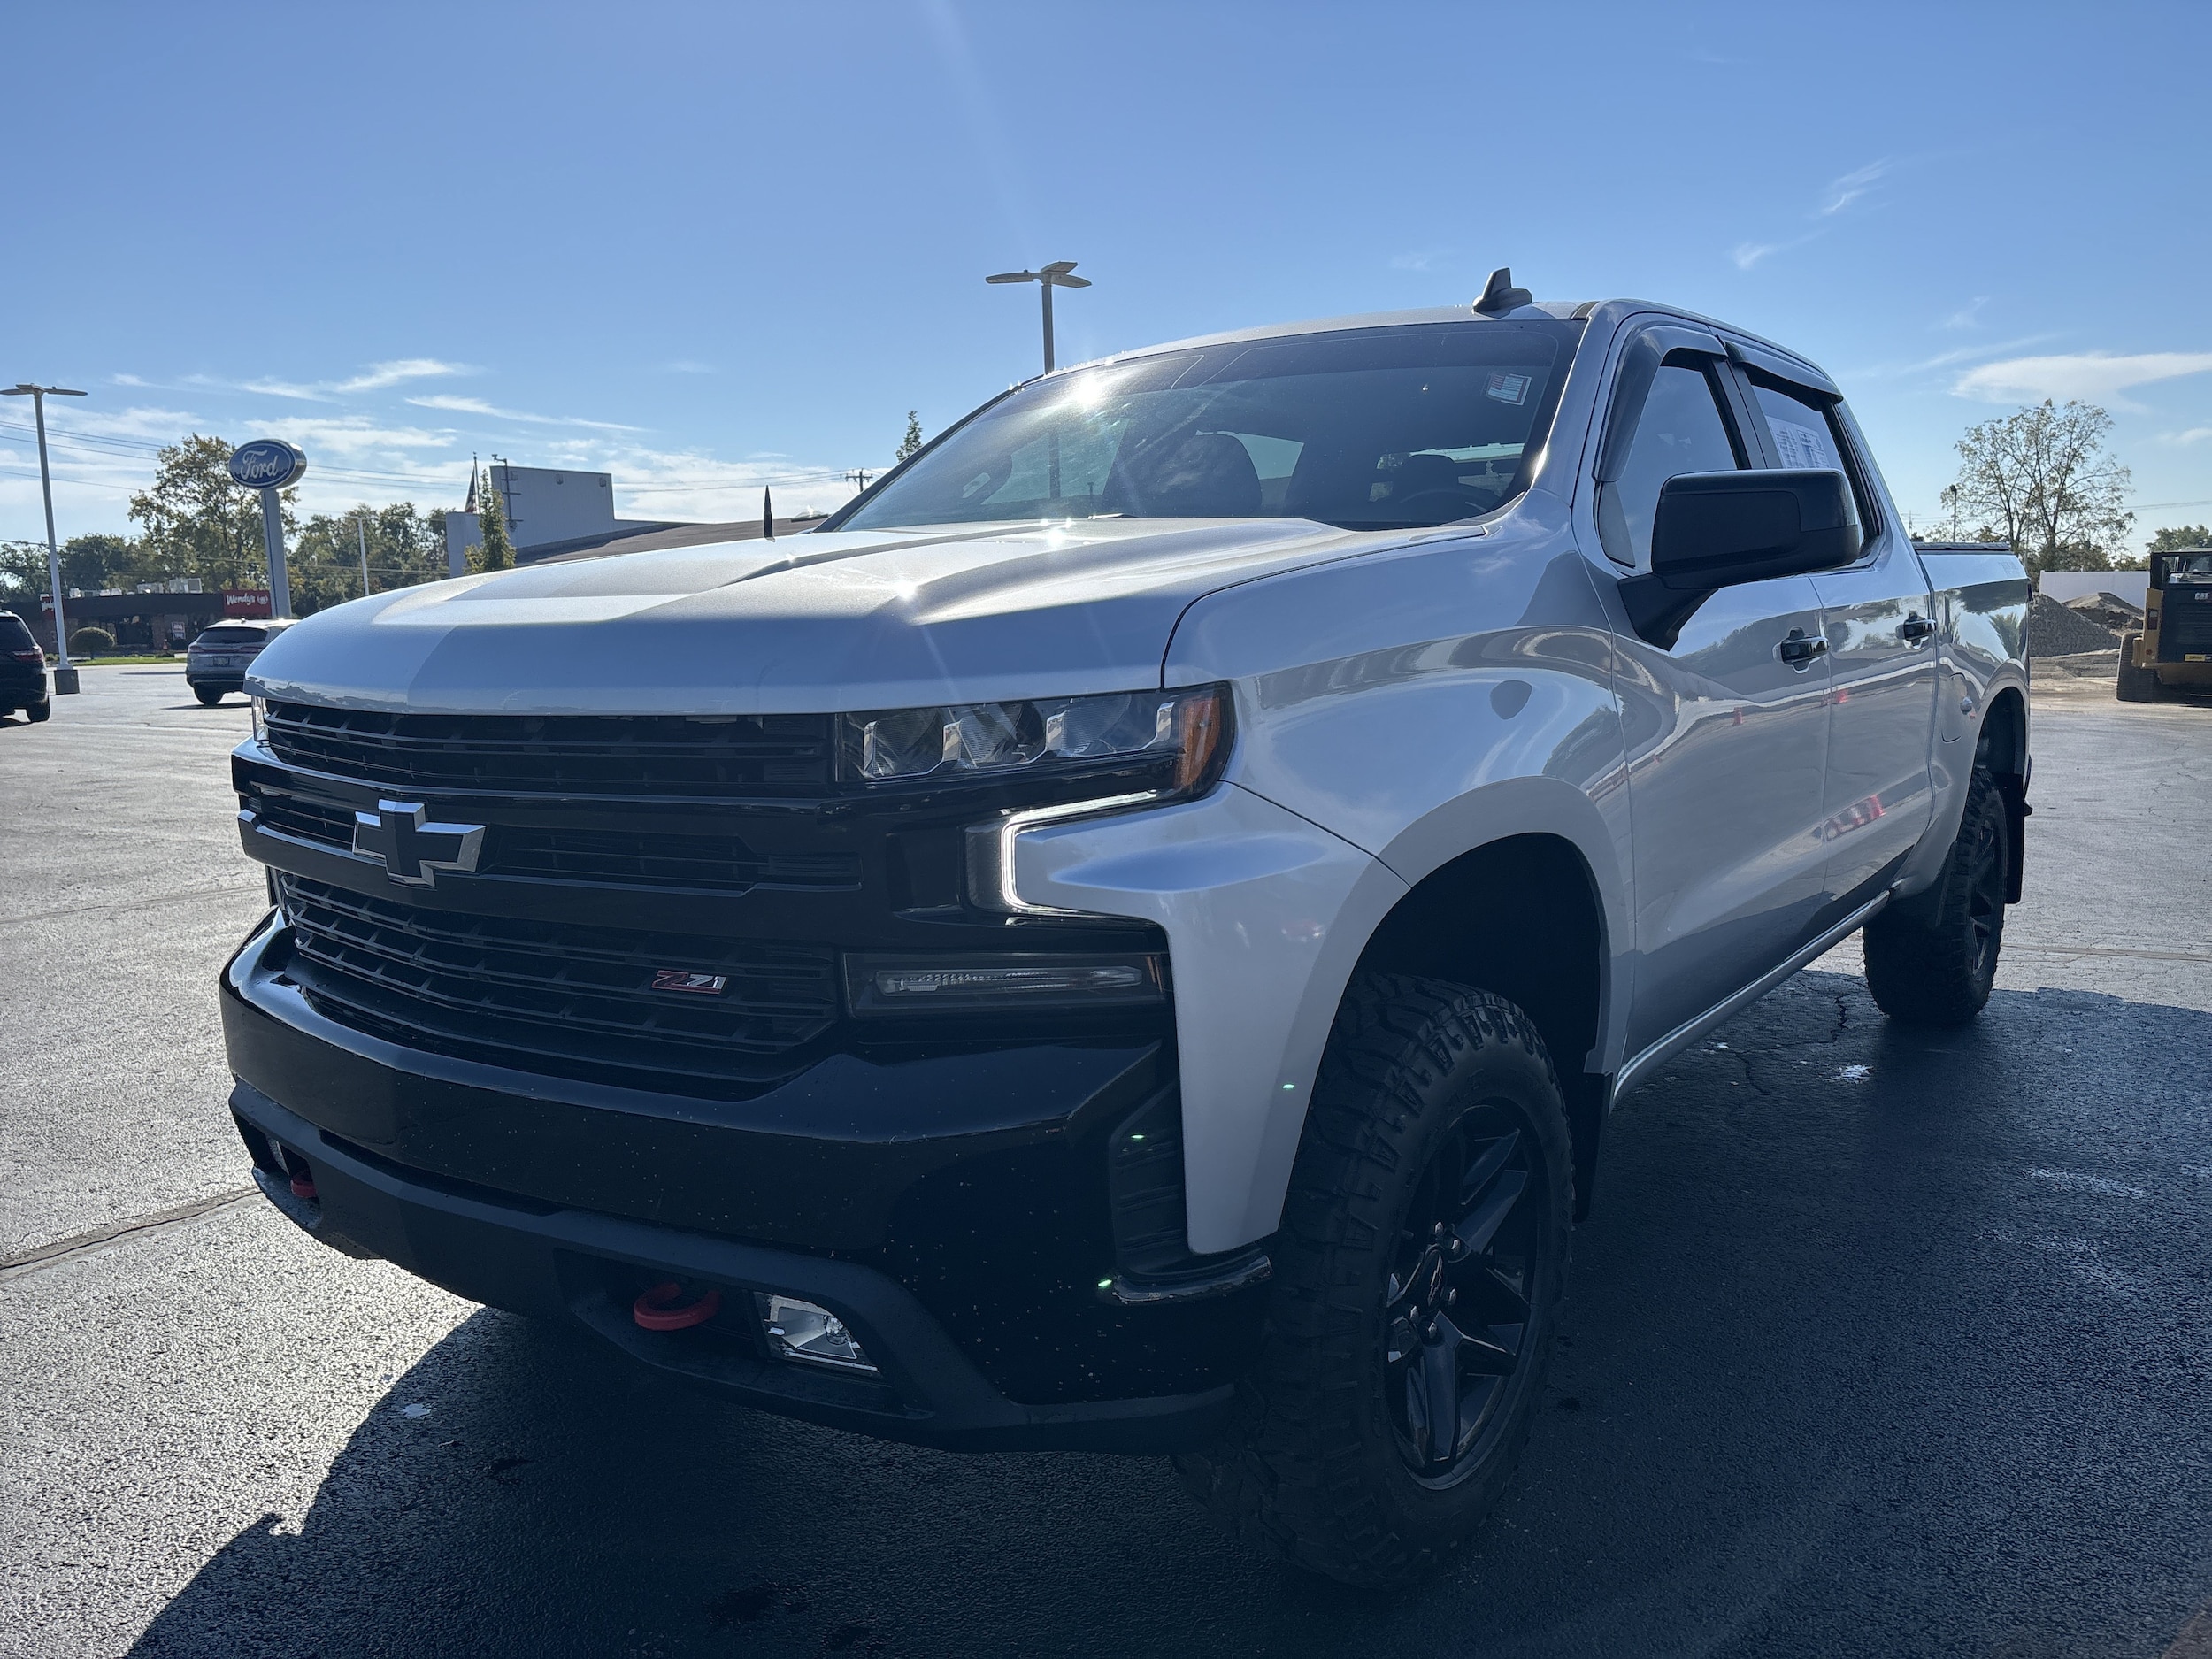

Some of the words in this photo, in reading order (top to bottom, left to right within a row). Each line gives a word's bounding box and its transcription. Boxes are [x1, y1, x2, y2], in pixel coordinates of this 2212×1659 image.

[240, 449, 278, 480] Ford
[226, 592, 256, 606] Wendy's
[2194, 592, 2209, 601] CAT
[651, 970, 727, 995] Z71
